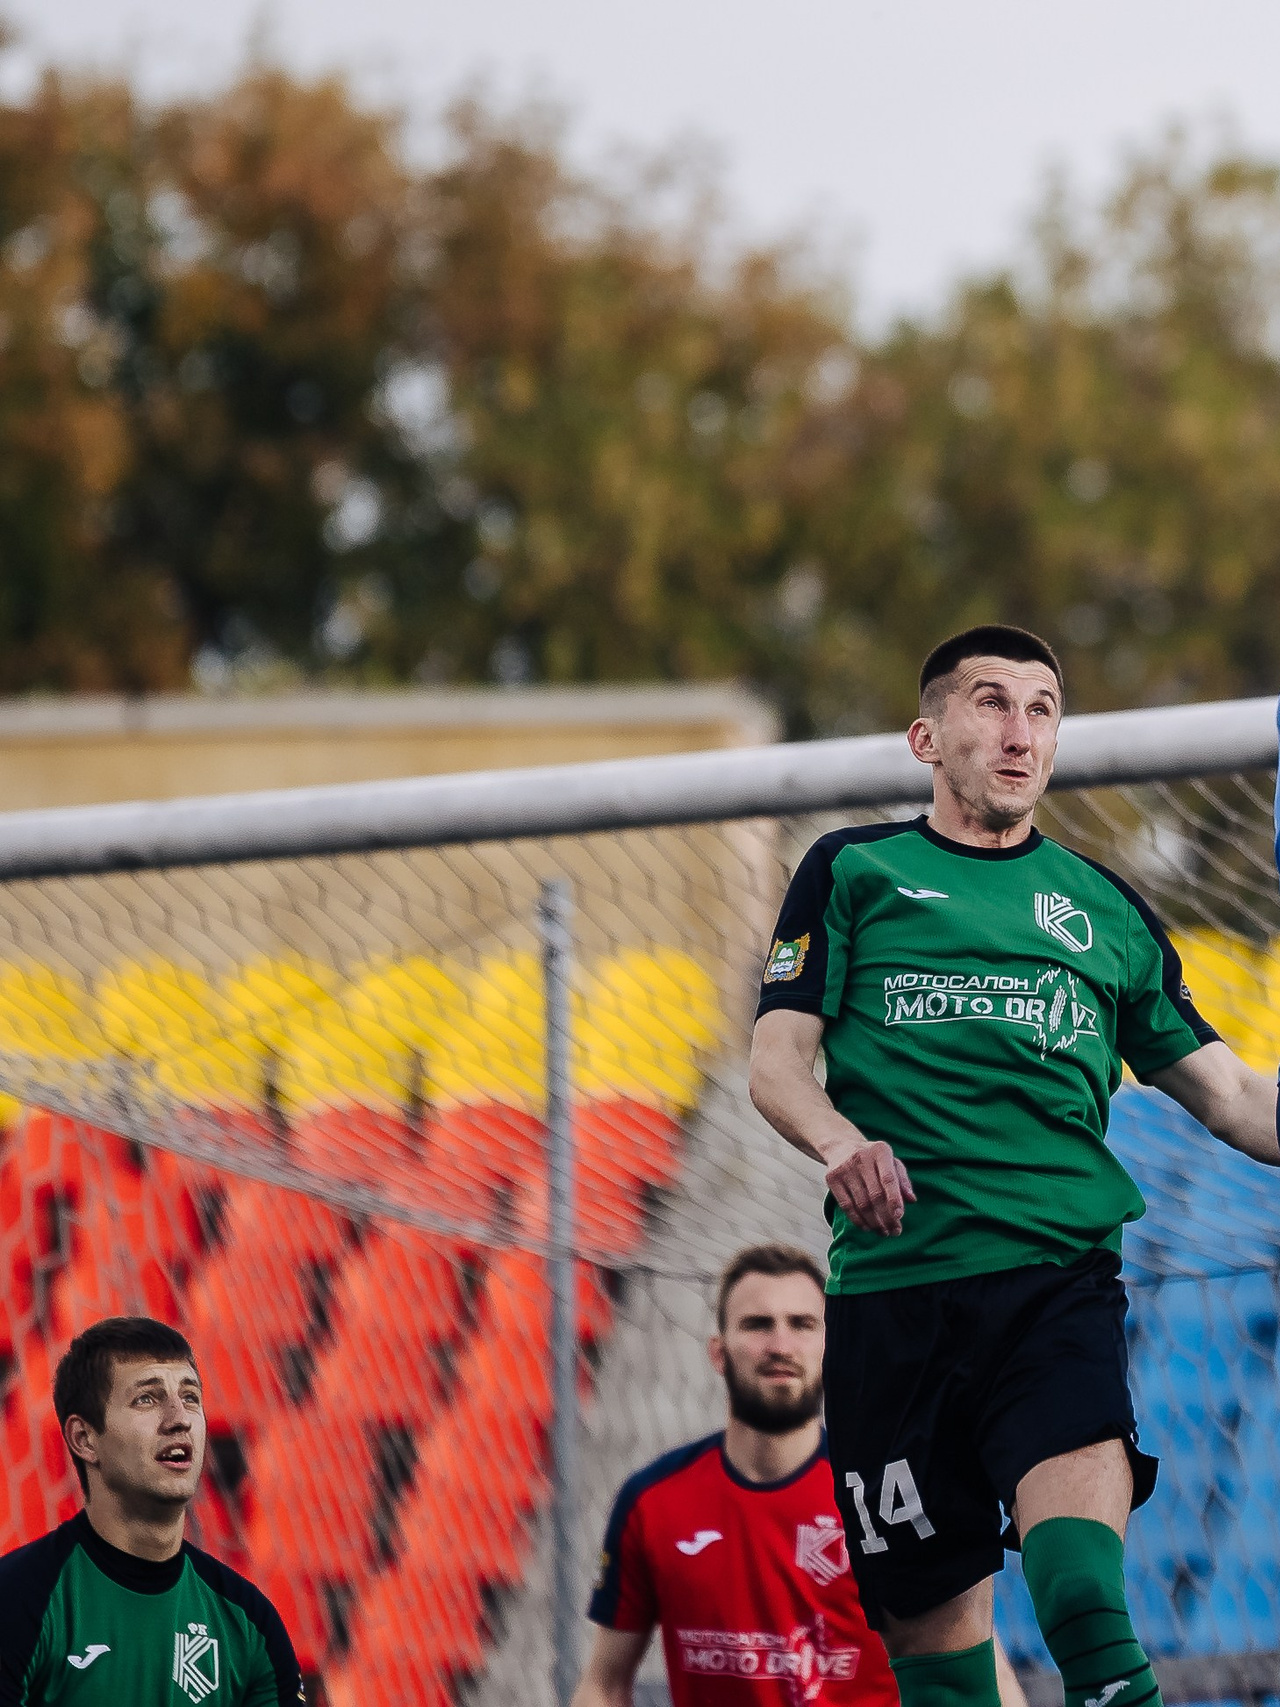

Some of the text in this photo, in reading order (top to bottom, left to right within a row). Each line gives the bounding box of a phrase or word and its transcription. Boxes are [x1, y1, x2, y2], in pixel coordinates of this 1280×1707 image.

[884, 973, 1029, 991] МОТОСАЛОН
[894, 992, 994, 1021] MOTO
[845, 1458, 936, 1554] 14
[683, 1647, 759, 1674] MOTO
